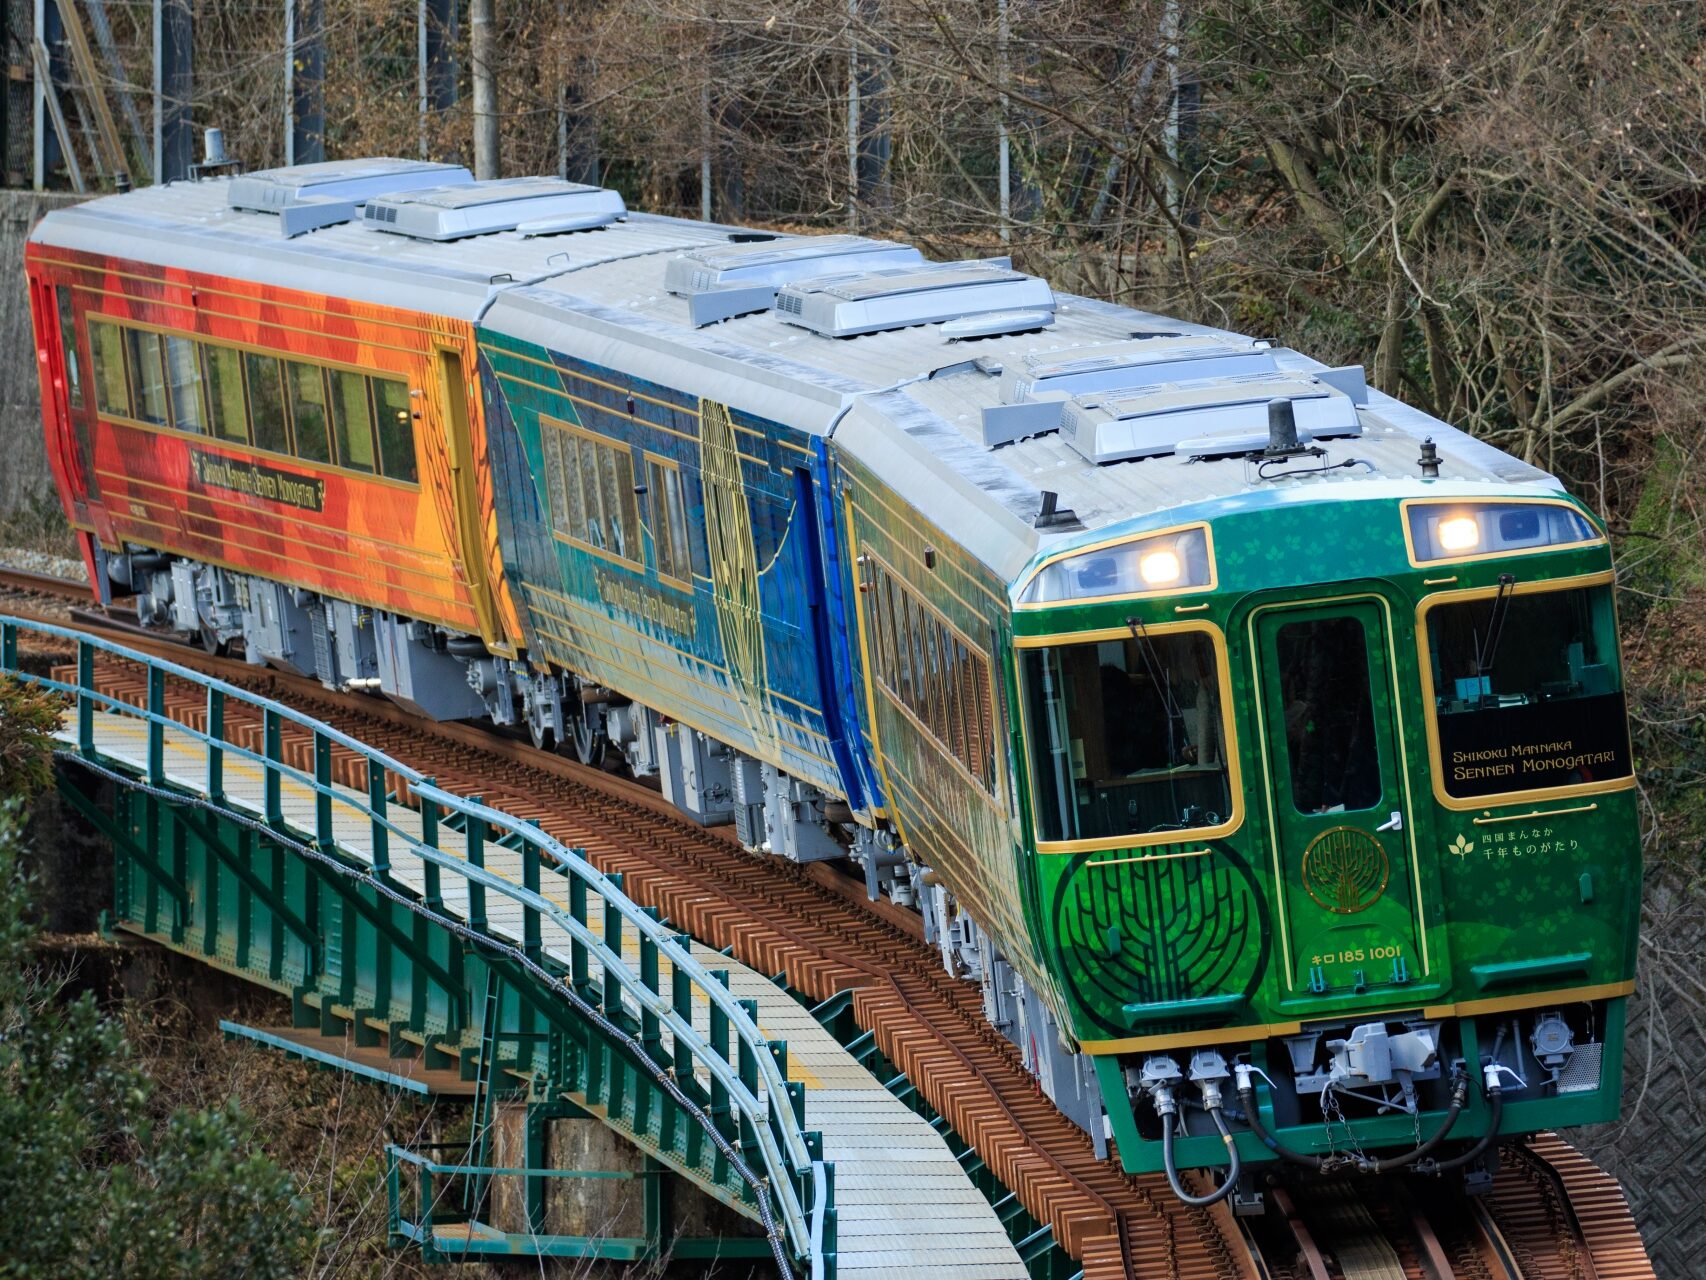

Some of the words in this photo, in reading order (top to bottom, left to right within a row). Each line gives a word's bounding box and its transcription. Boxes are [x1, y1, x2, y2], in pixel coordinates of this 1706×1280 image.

[1453, 749, 1507, 763] SHIKOKU
[1511, 740, 1573, 757] MANNAKA
[1454, 764, 1515, 781] SENNEN
[1522, 751, 1615, 773] MONOGATARI
[1482, 827, 1553, 844] 四国まんなか
[1483, 839, 1578, 860] 千年ものがたり
[1312, 954, 1335, 965] キロ
[1339, 949, 1365, 964] 185
[1369, 945, 1401, 960] 1001
